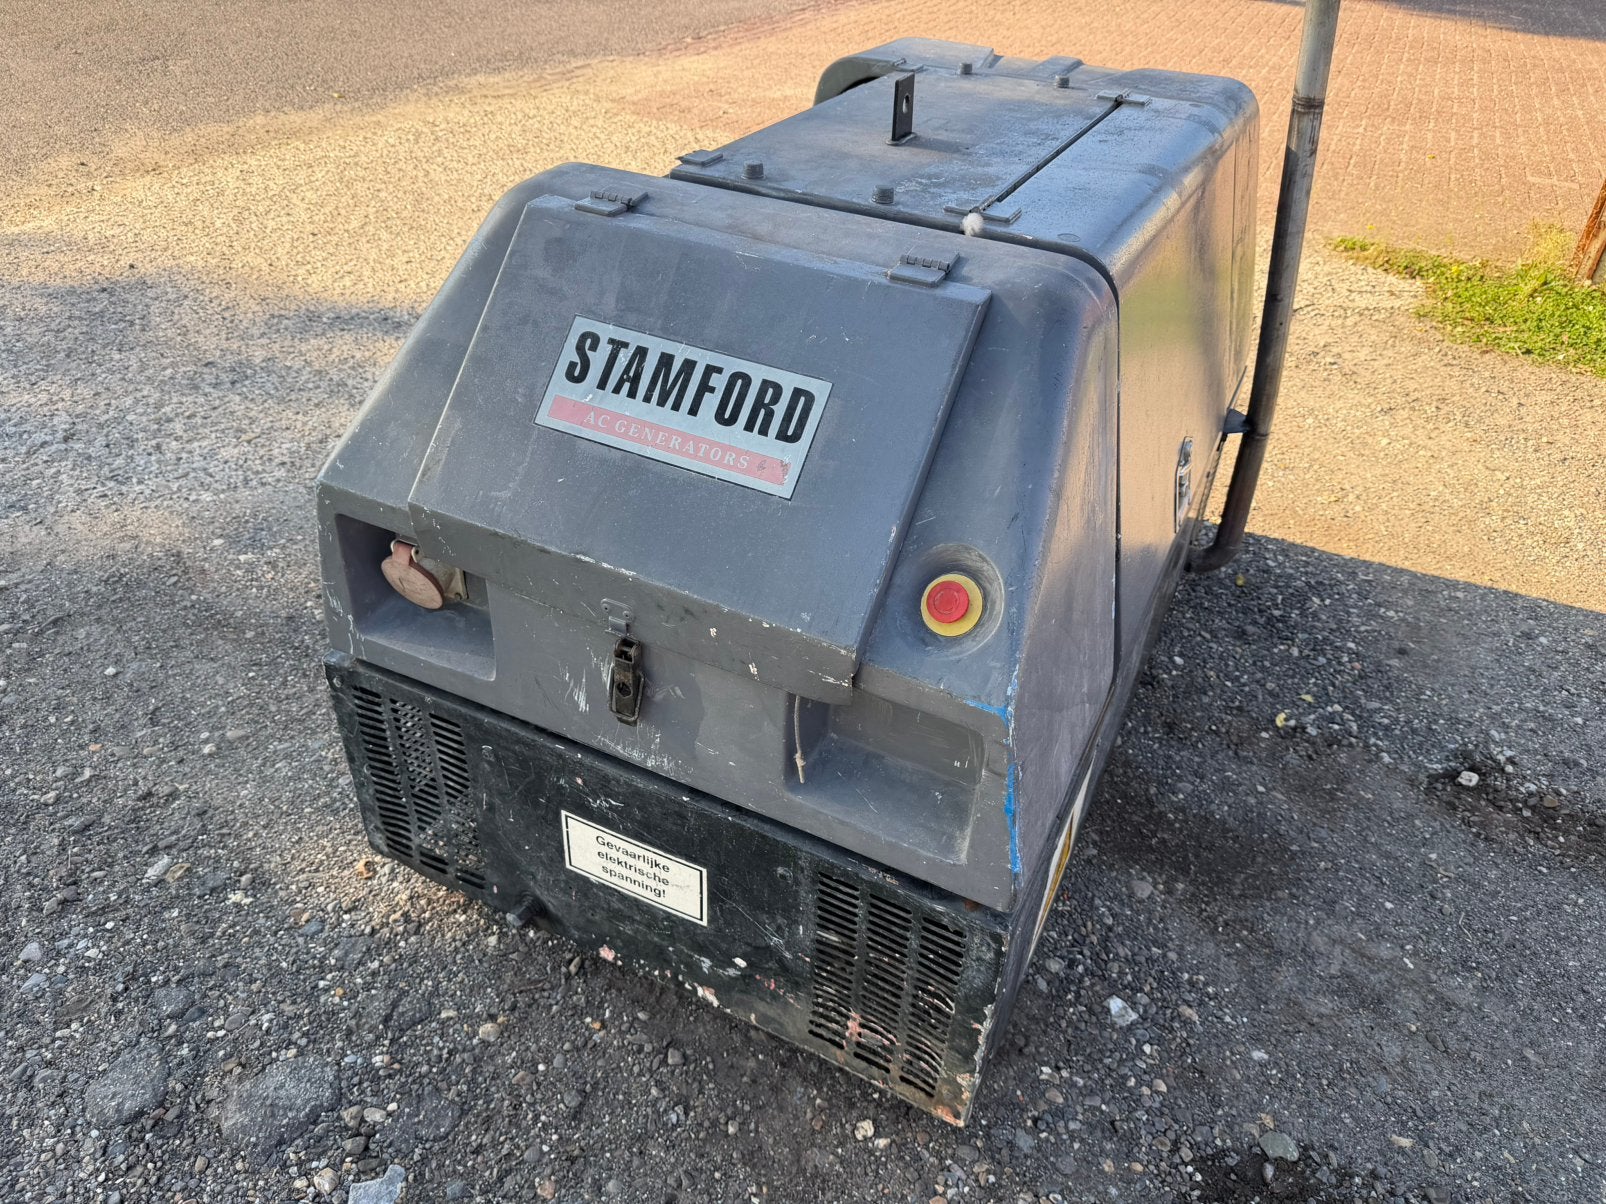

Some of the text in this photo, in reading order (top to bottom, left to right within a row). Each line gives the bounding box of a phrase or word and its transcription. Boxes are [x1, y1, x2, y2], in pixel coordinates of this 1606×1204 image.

[564, 330, 816, 444] STAMFORD
[583, 411, 750, 470] AC GENERATORS
[595, 835, 670, 873] Gevaarlijke
[597, 851, 670, 886] elektrische
[601, 865, 666, 898] spanning!
